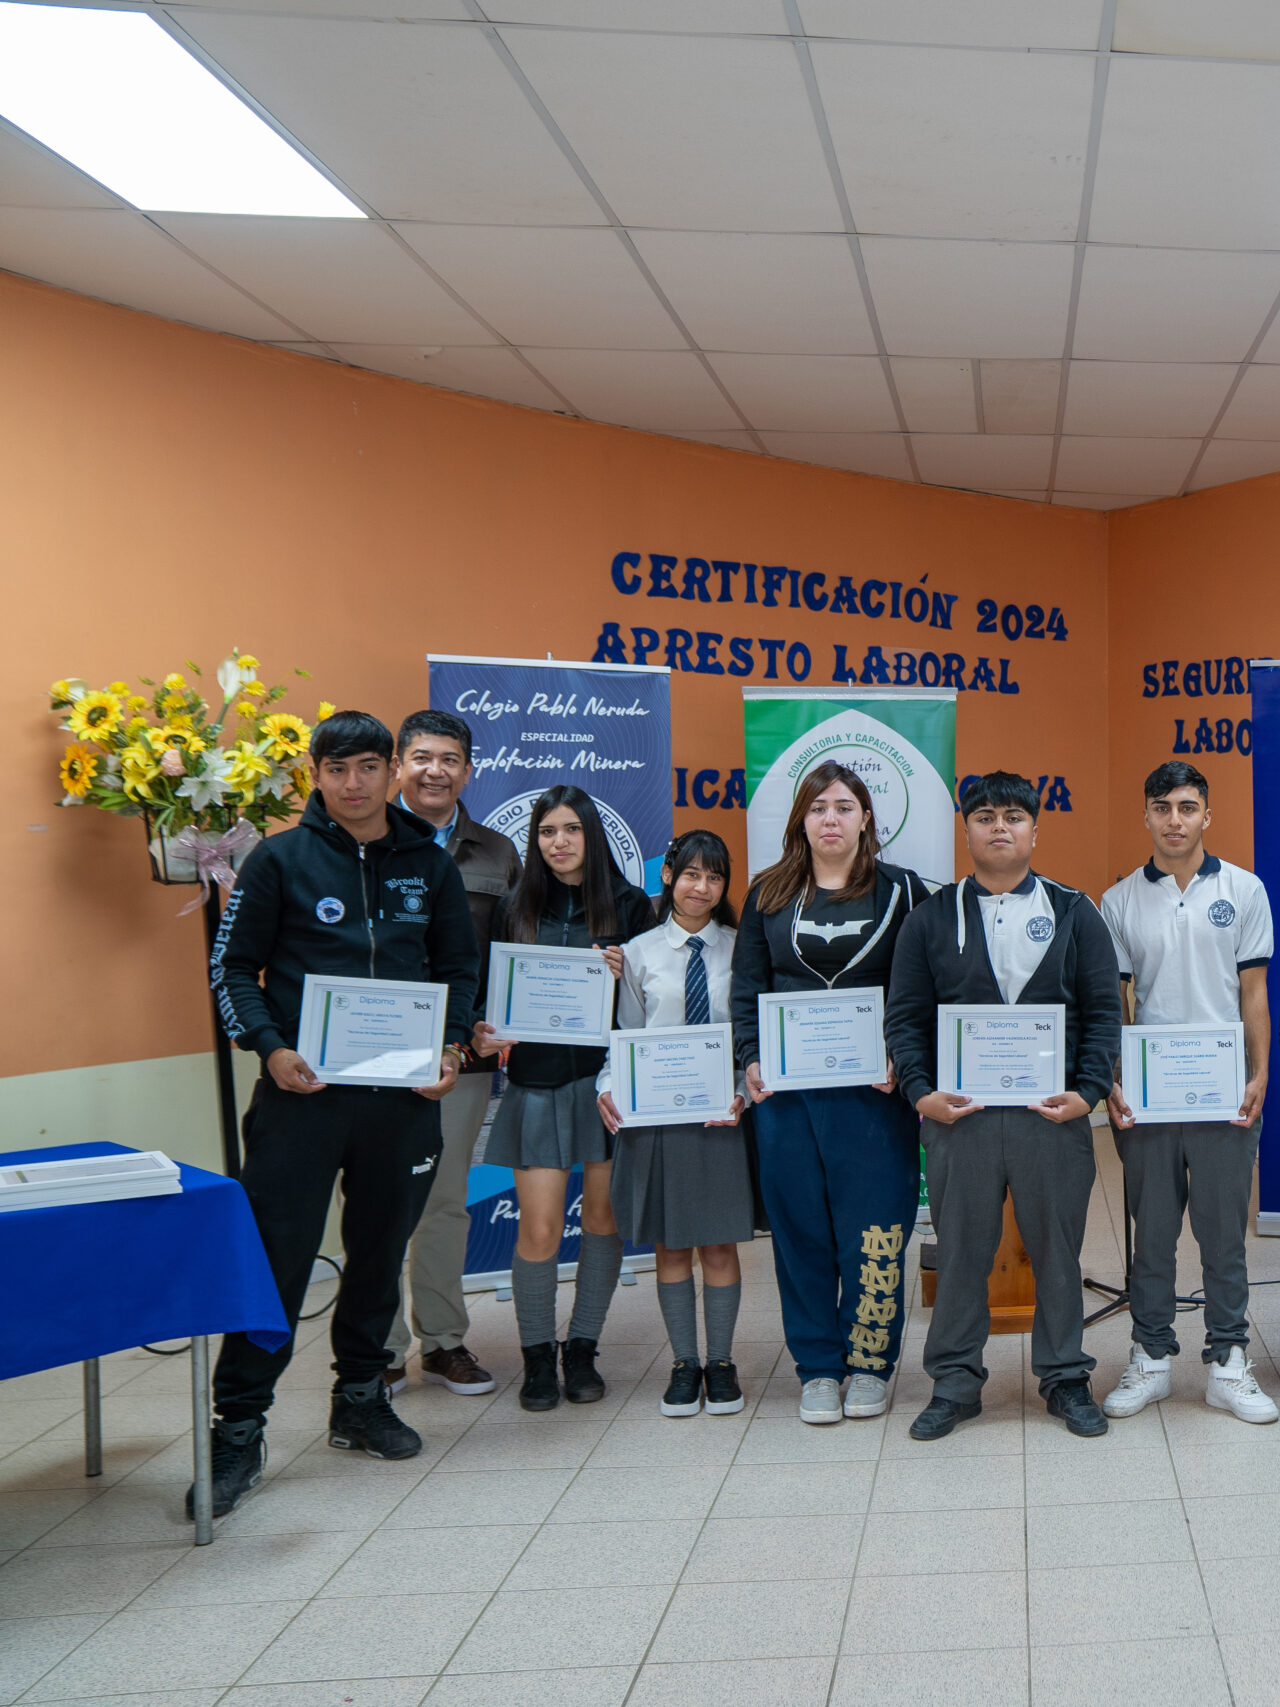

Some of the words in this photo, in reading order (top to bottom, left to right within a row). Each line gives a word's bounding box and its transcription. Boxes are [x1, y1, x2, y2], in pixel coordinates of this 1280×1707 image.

[611, 551, 959, 630] CERTIFICACIÓN
[976, 598, 1069, 642] 2024
[590, 622, 812, 682] APRESTO
[832, 644, 1020, 695] LABORAL
[455, 689, 519, 720] Colegio
[527, 692, 577, 718] Pablo
[583, 697, 650, 717] Neruda
[520, 732, 594, 743] ESPECIALIDAD
[1172, 717, 1252, 757] LABO
[570, 749, 646, 773] Minera
[787, 734, 842, 779] CONSULTORIA
[845, 733, 851, 742] Y
[600, 809, 635, 862] ERUDA
[538, 961, 571, 971] Diploma
[586, 967, 602, 975] Teck
[359, 995, 396, 1006] Diploma
[412, 1001, 432, 1011] Teck
[808, 1006, 840, 1015] Diploma
[855, 1005, 873, 1014] Teck
[986, 1021, 1019, 1030] Diploma
[1034, 1023, 1052, 1031] Teck
[658, 1042, 689, 1051] Diploma
[704, 1041, 721, 1050] Teck
[1170, 1040, 1201, 1048] Diploma
[1216, 1040, 1233, 1048] Teck
